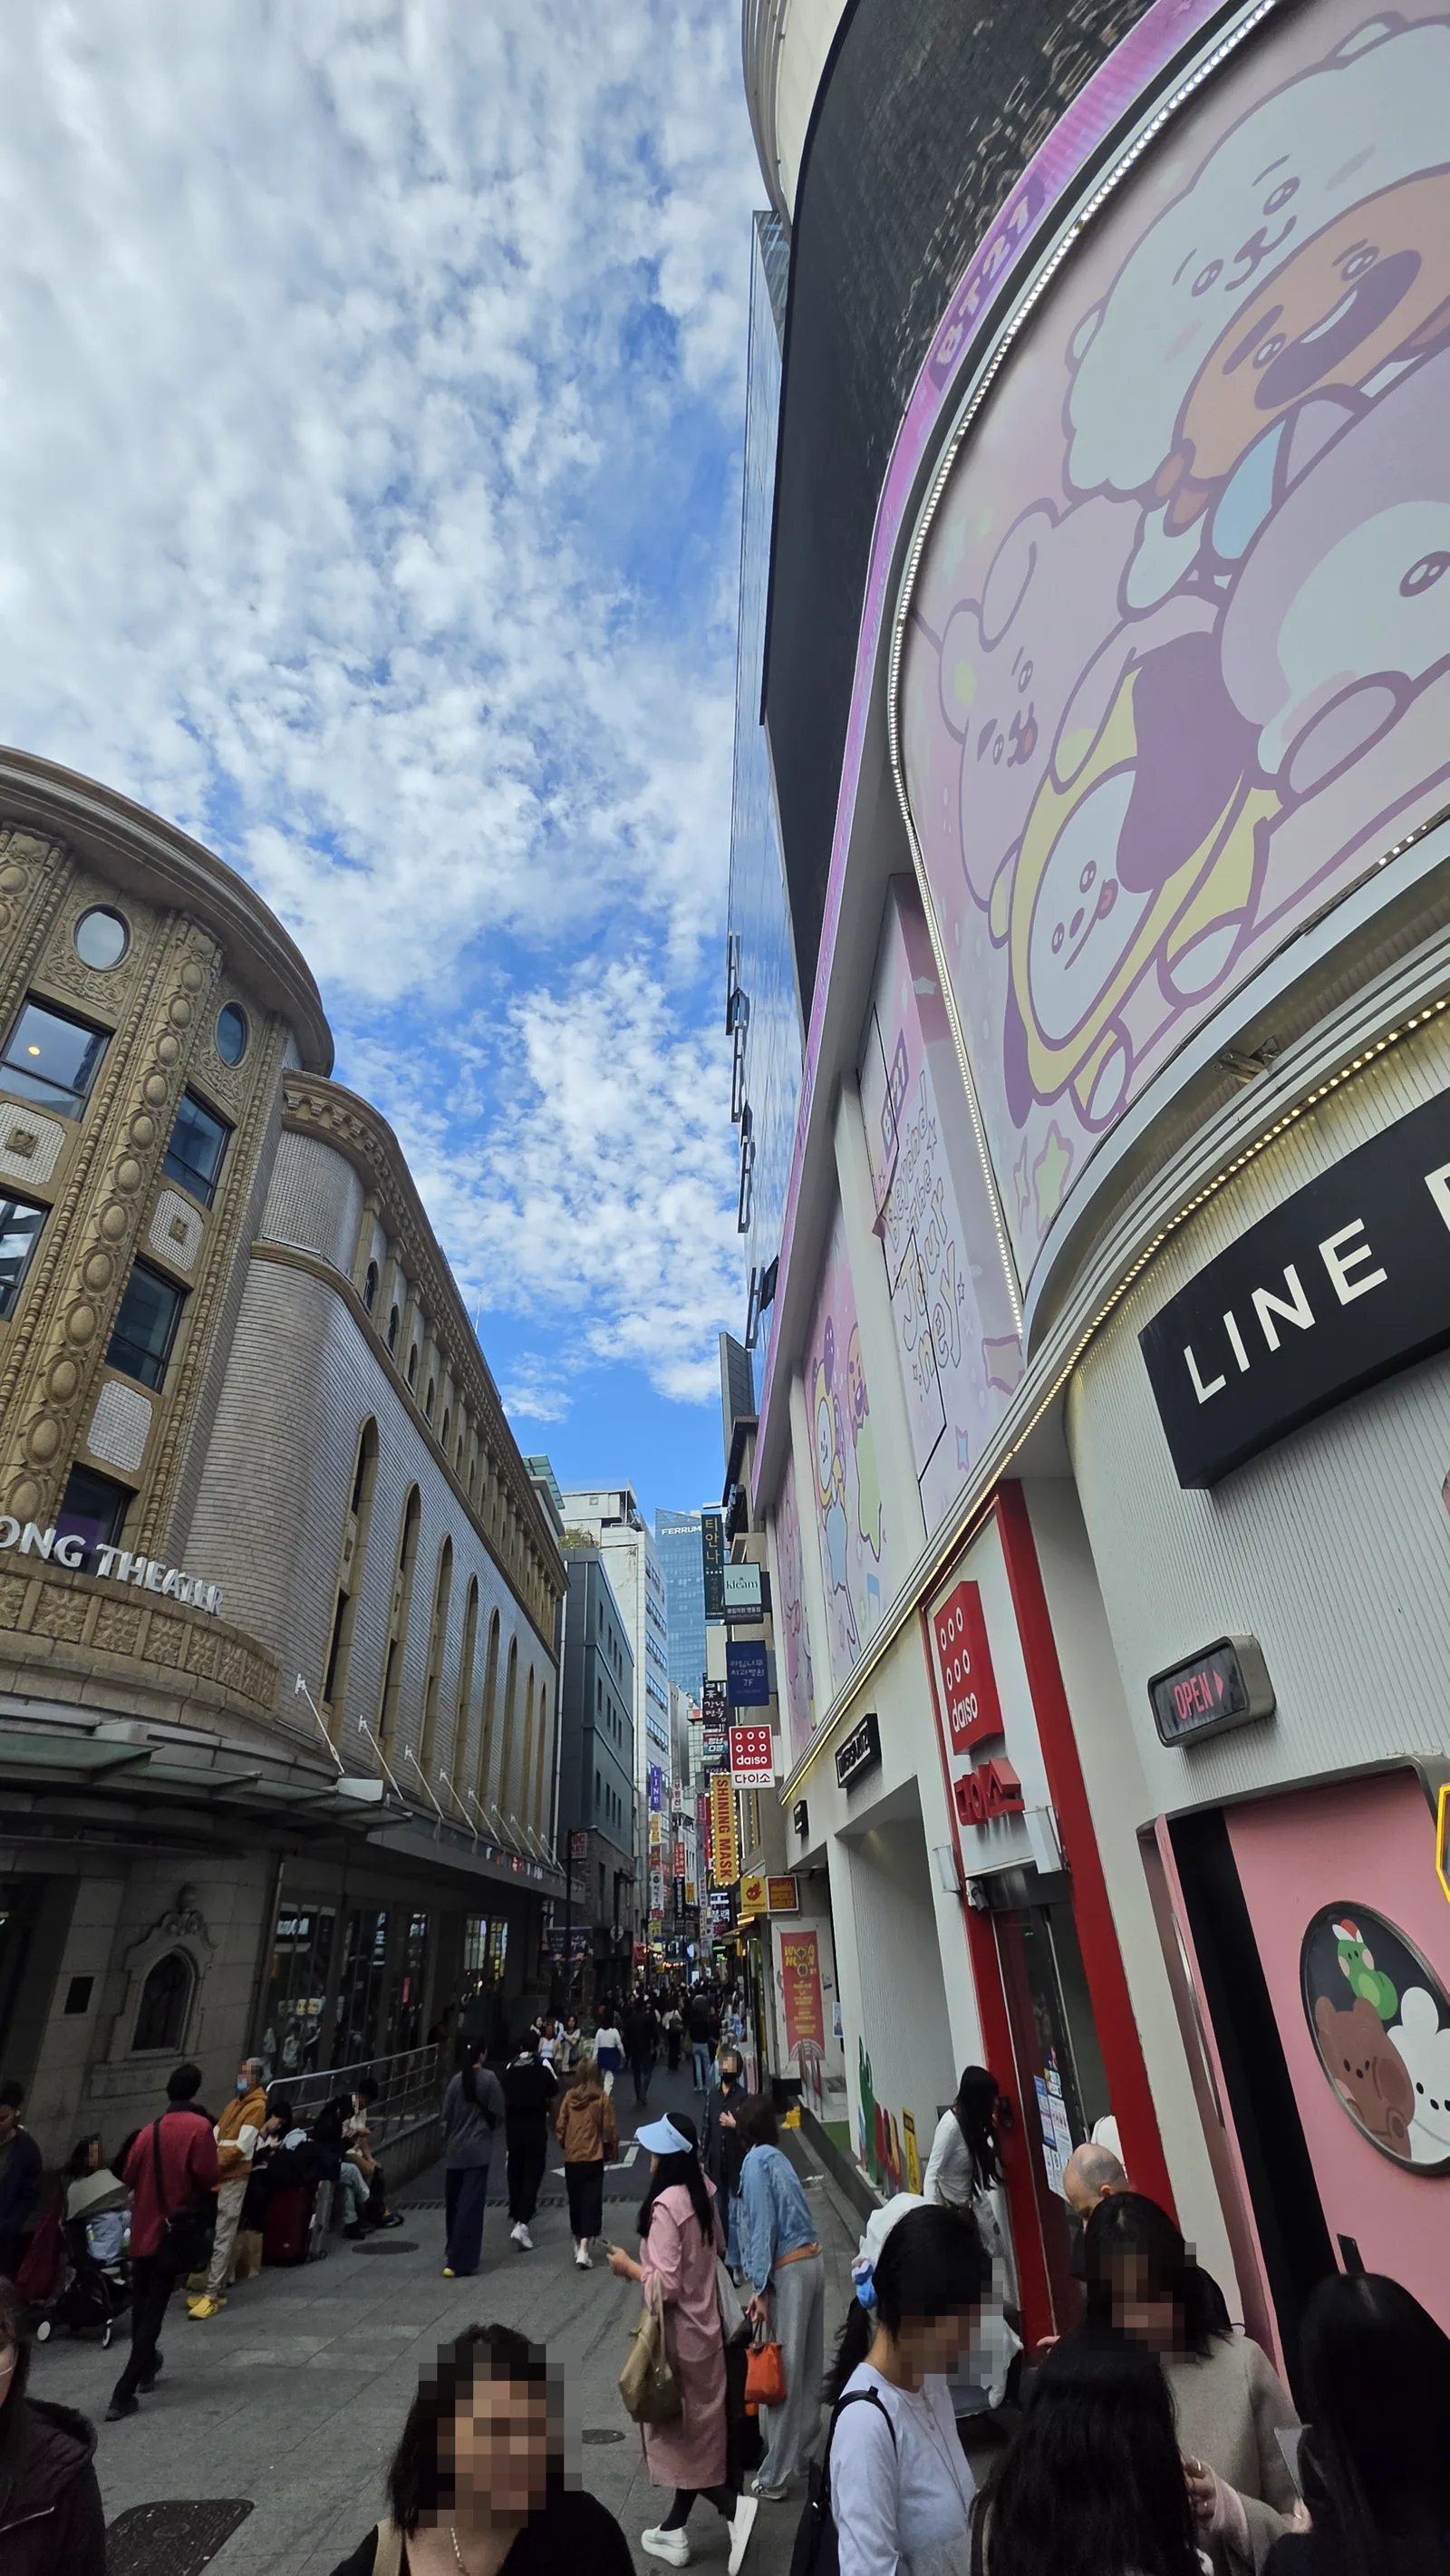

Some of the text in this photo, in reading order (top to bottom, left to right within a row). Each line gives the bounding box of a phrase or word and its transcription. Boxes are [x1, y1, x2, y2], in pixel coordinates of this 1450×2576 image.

[936, 196, 1029, 363] BT21
[1184, 1218, 1387, 1404] LINE
[662, 1525, 701, 1535] FERRUM
[705, 1517, 720, 1564] 티안나
[96, 1543, 223, 1616] THEATER
[743, 1678, 753, 1687] 7F
[1174, 1672, 1213, 1719] OPEN
[952, 1692, 978, 1732] daiso
[735, 1773, 771, 1784] 다이소
[736, 1755, 768, 1766] daiso
[717, 1779, 732, 1878] SHINING MASK
